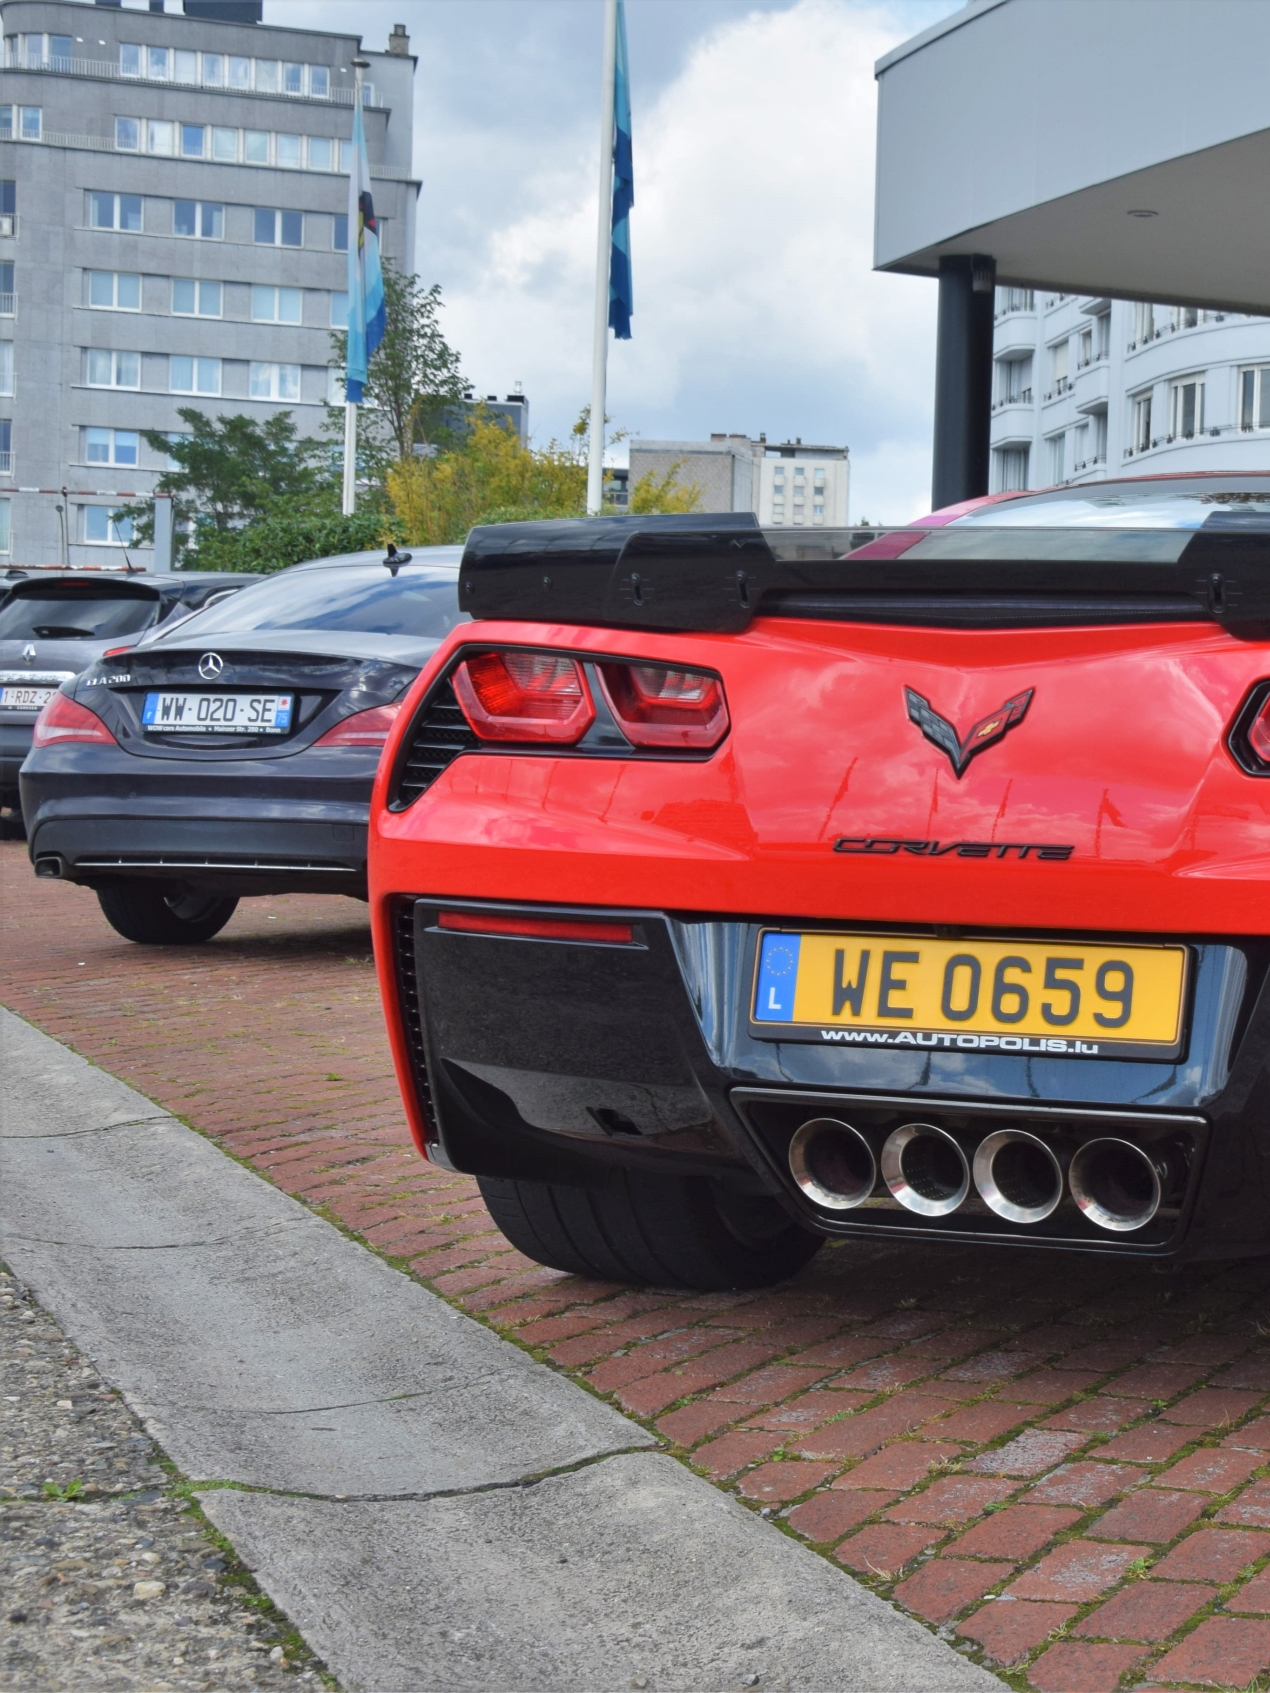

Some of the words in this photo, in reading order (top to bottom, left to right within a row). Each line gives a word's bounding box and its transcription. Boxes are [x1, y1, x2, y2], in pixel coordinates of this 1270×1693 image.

[146, 711, 153, 719] F
[161, 697, 275, 723] WW-020-SE
[276, 713, 288, 724] 75
[833, 838, 1075, 860] CORVETTE
[768, 986, 782, 1010] L
[831, 948, 920, 1019] WE
[941, 953, 1135, 1029] 0659
[820, 1030, 1099, 1054] www.AUTOPOLIS.lu
